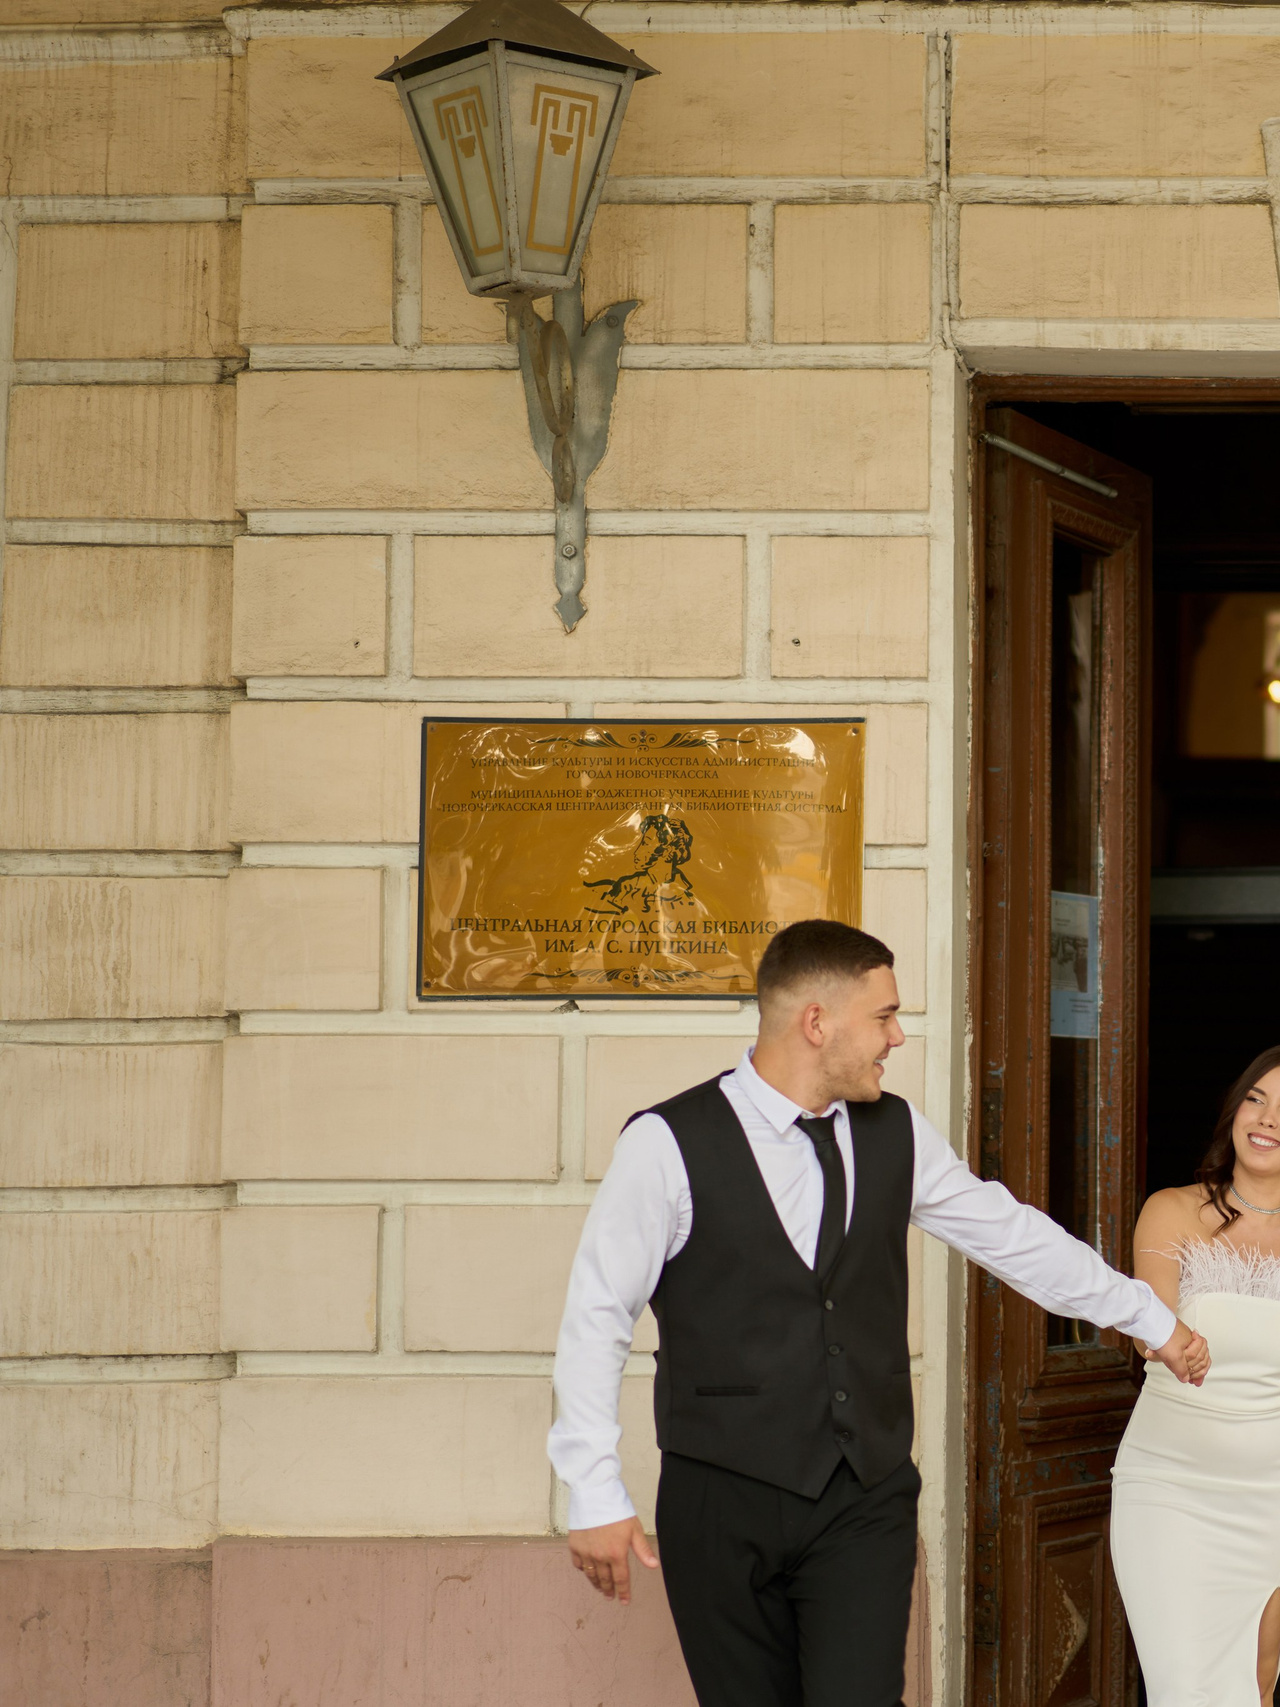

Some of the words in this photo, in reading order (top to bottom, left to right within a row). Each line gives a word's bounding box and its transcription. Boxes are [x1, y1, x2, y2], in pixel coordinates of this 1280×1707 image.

[471, 757, 548, 768] УПРАВЛЕНИЕ
[552, 757, 613, 767] КУЛЬТУРЫ
[616, 757, 625, 766] И
[629, 757, 700, 768] ИСКУССТВА
[703, 756, 815, 768] АДМИНИСТРАЦИИ
[566, 770, 612, 779] ГОРОДА
[616, 769, 719, 780] НОВОЧЕРКАССКА
[470, 789, 582, 800] МУНИЦИПАЛЬНОЕ
[586, 789, 664, 799] БЮДЖЕТНОЕ
[669, 788, 750, 800] УЧРЕЖДЕНИЕ
[753, 790, 814, 800] КУЛЬТУРЫ
[686, 802, 782, 812] БИБЛИОТЕЧНАЯ
[450, 918, 582, 934] ЦЕНТРАЛЬНАЯ
[588, 920, 696, 934] ГОРОДСКАЯ
[702, 920, 798, 934] БИБЛИОТ
[545, 940, 578, 952] ИМ.
[607, 940, 623, 953] С.
[628, 940, 729, 954] ПУШКИНА
